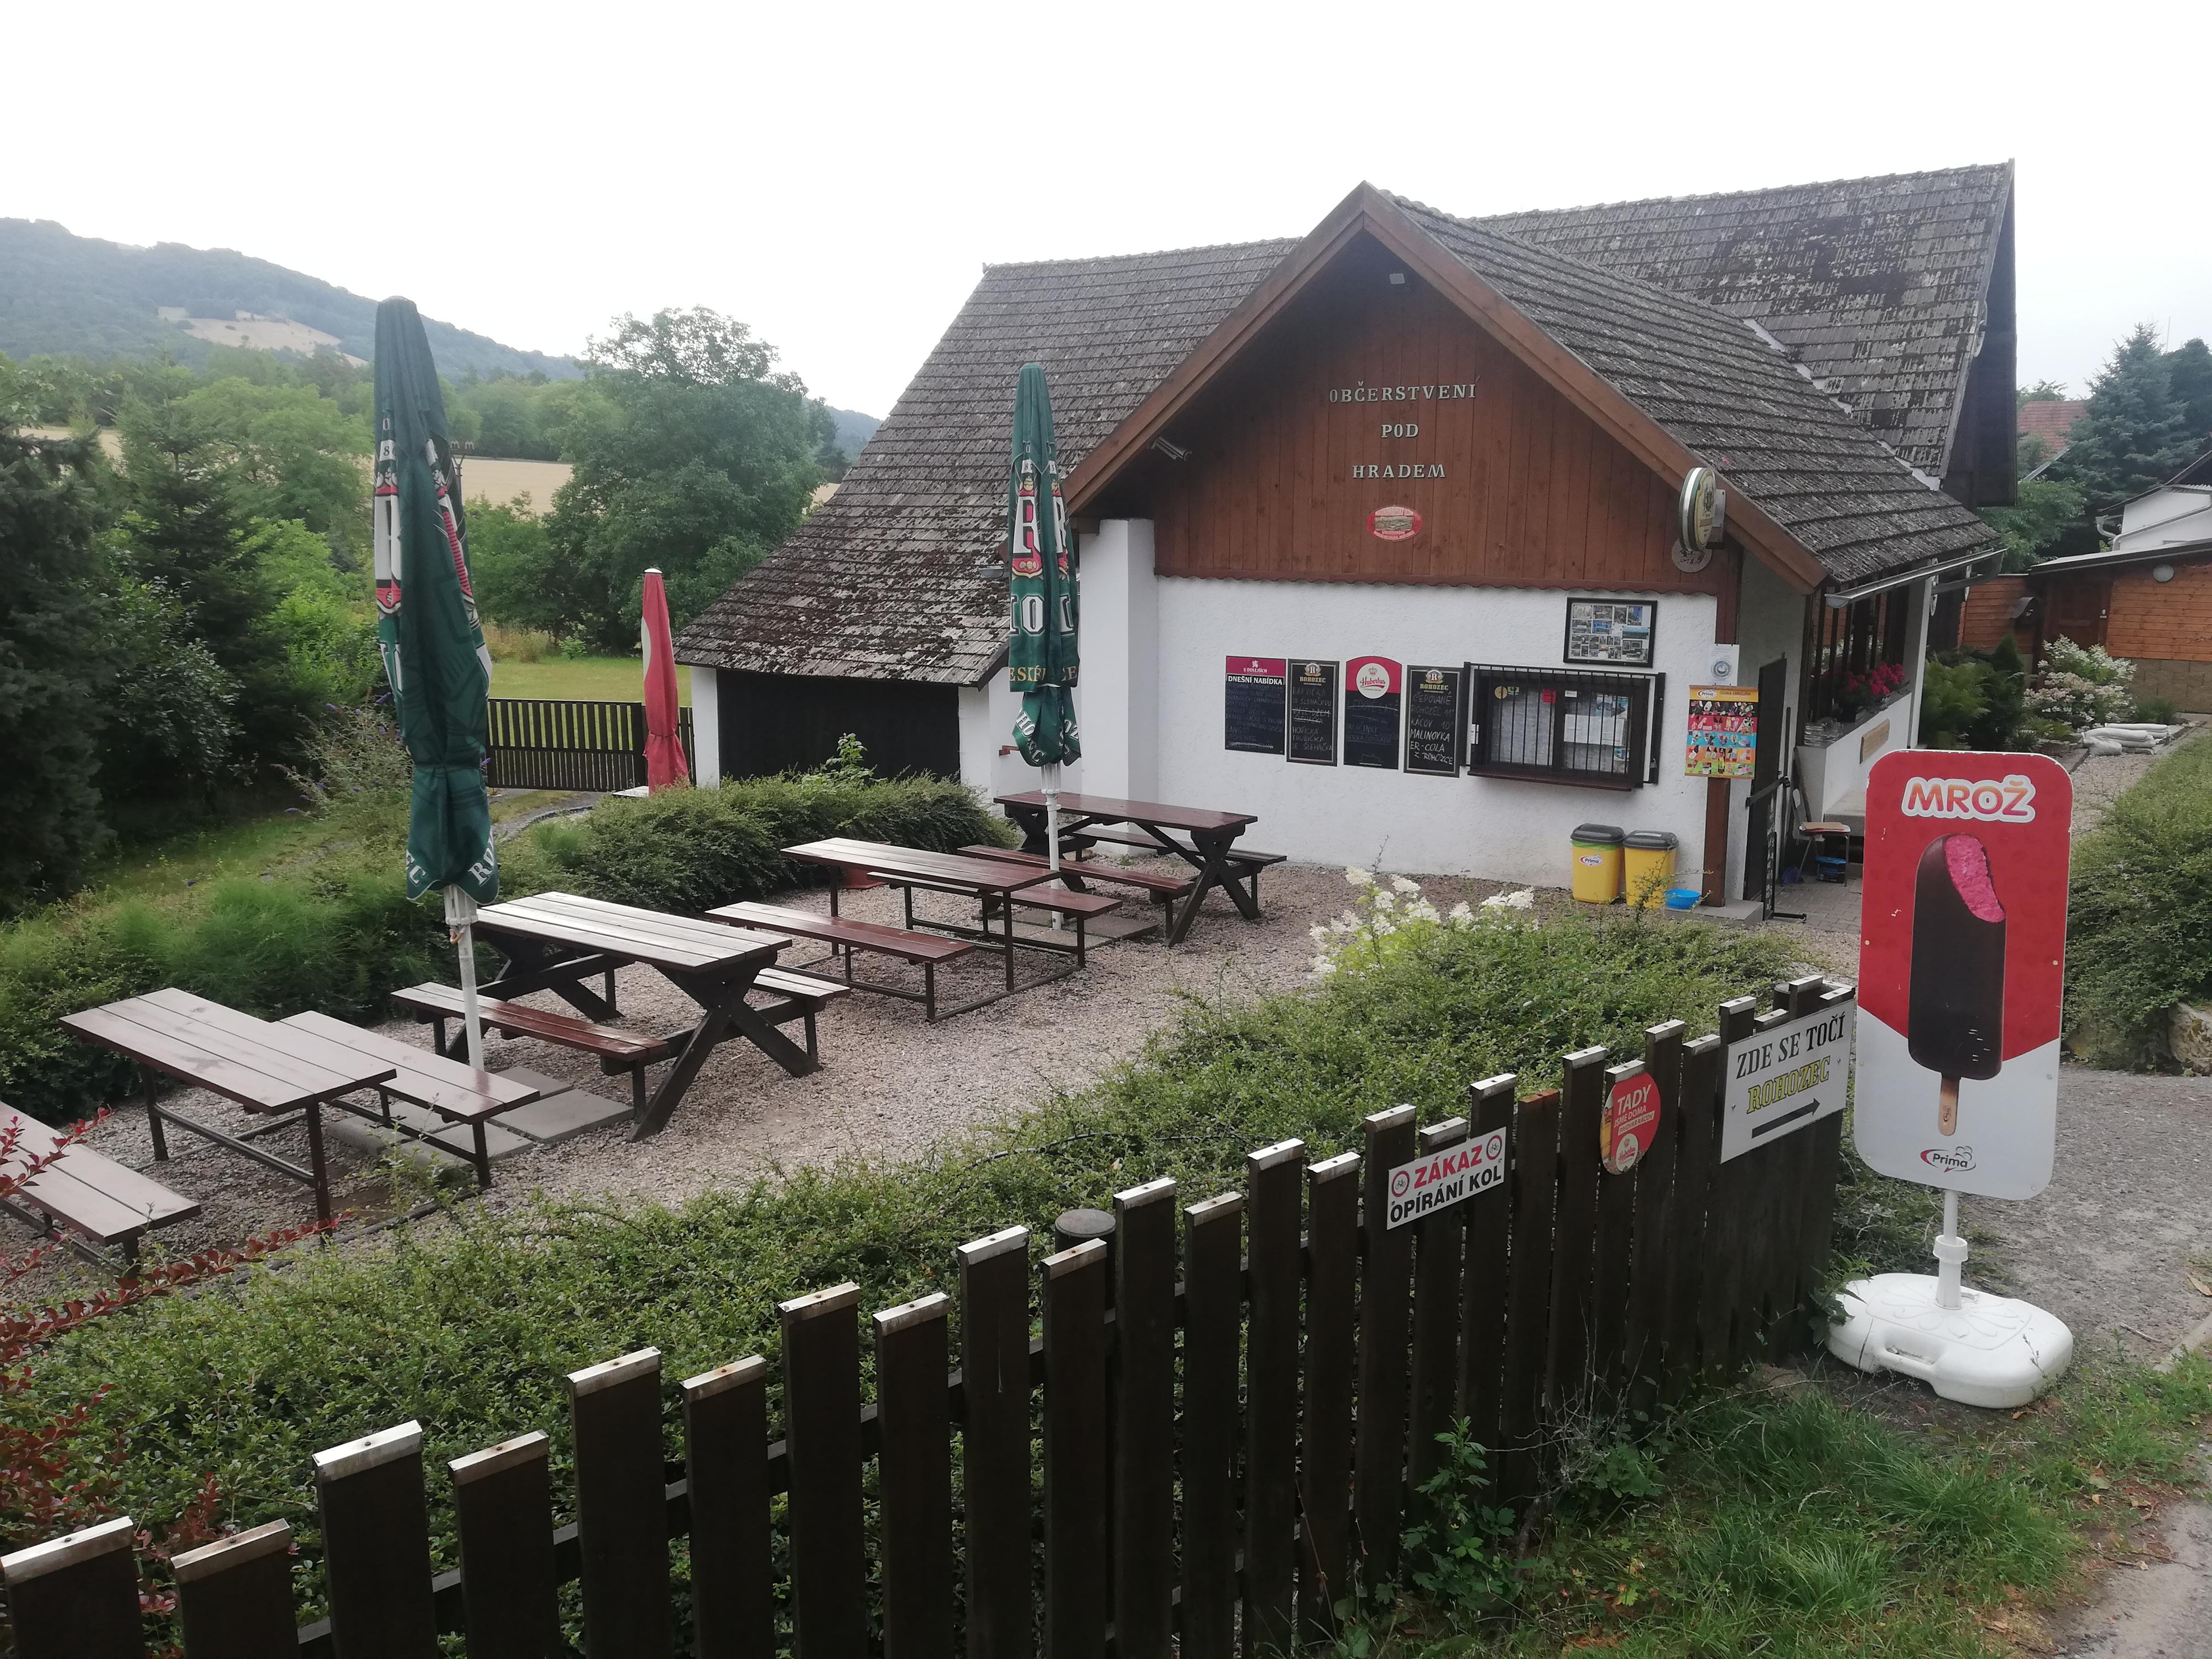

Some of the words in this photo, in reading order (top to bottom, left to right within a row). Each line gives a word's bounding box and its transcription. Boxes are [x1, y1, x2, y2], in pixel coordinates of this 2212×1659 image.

[1381, 424, 1420, 438] POD
[1353, 464, 1446, 478] HRADEM
[1253, 677, 1282, 685] NABÍDKA
[1360, 676, 1386, 686] Hubertus
[1410, 728, 1451, 742] MALINOVKA
[1907, 779, 2030, 817] MROŽ
[1736, 1043, 1772, 1079] ZDE
[1778, 1032, 1801, 1063] SE
[1806, 1011, 1845, 1051] TOČÍ
[1746, 1055, 1830, 1114] ROHOZEC
[1618, 1084, 1652, 1115] TADY
[1614, 1113, 1628, 1128] JSME
[1627, 1105, 1646, 1120] DOMA
[1413, 1144, 1483, 1189] ZÁKAZ
[1932, 1153, 1968, 1168] Prima
[1390, 1174, 1465, 1223] OPÍRÁNÍ
[1469, 1165, 1502, 1192] KOL
